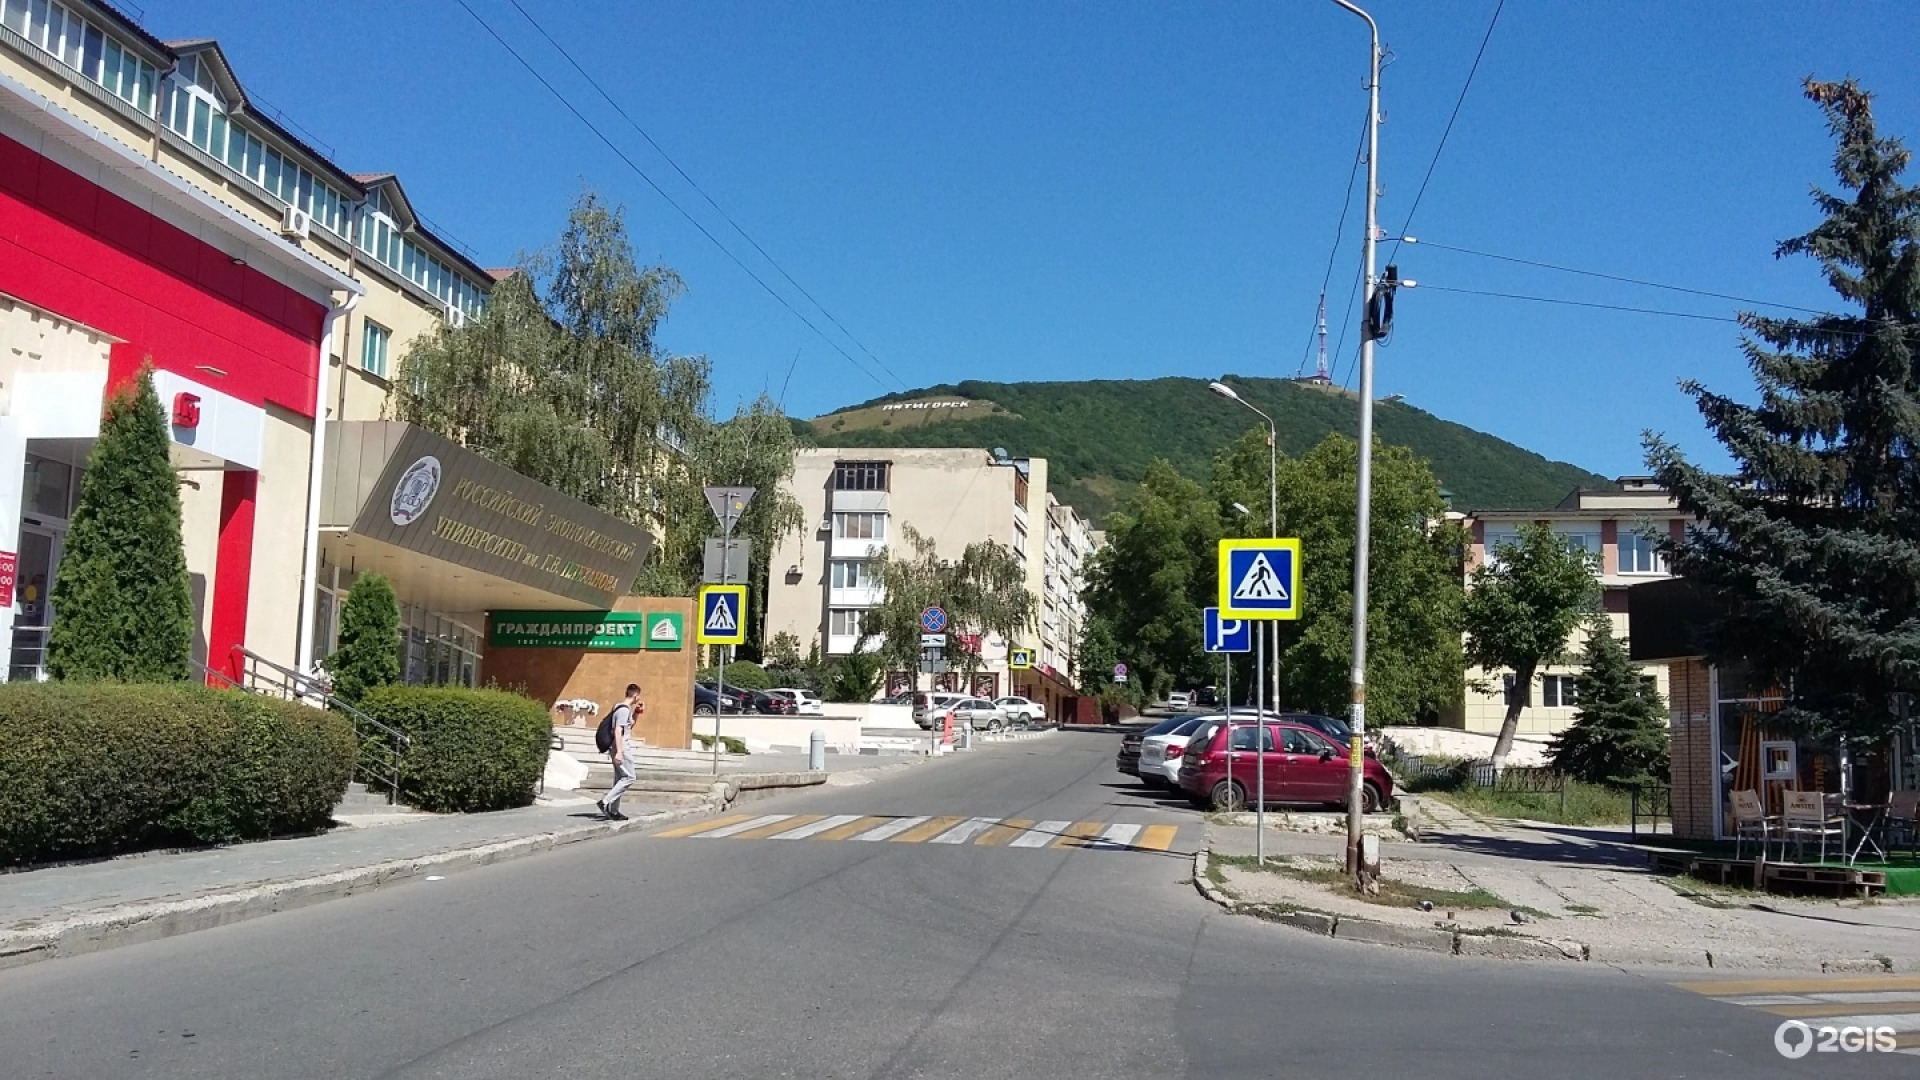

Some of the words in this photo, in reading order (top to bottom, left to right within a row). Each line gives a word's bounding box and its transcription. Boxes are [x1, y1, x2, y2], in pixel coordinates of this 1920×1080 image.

[882, 401, 969, 411] ПЯТИГОРСК
[451, 477, 544, 527] РОССИЙСКИЙ
[544, 514, 637, 561] ЭКОНОМИЧЕСКИЙ
[431, 515, 527, 562] УНИВЕРСИТЕТ
[497, 622, 636, 636] ГРАЖДАНПРОЕКТ
